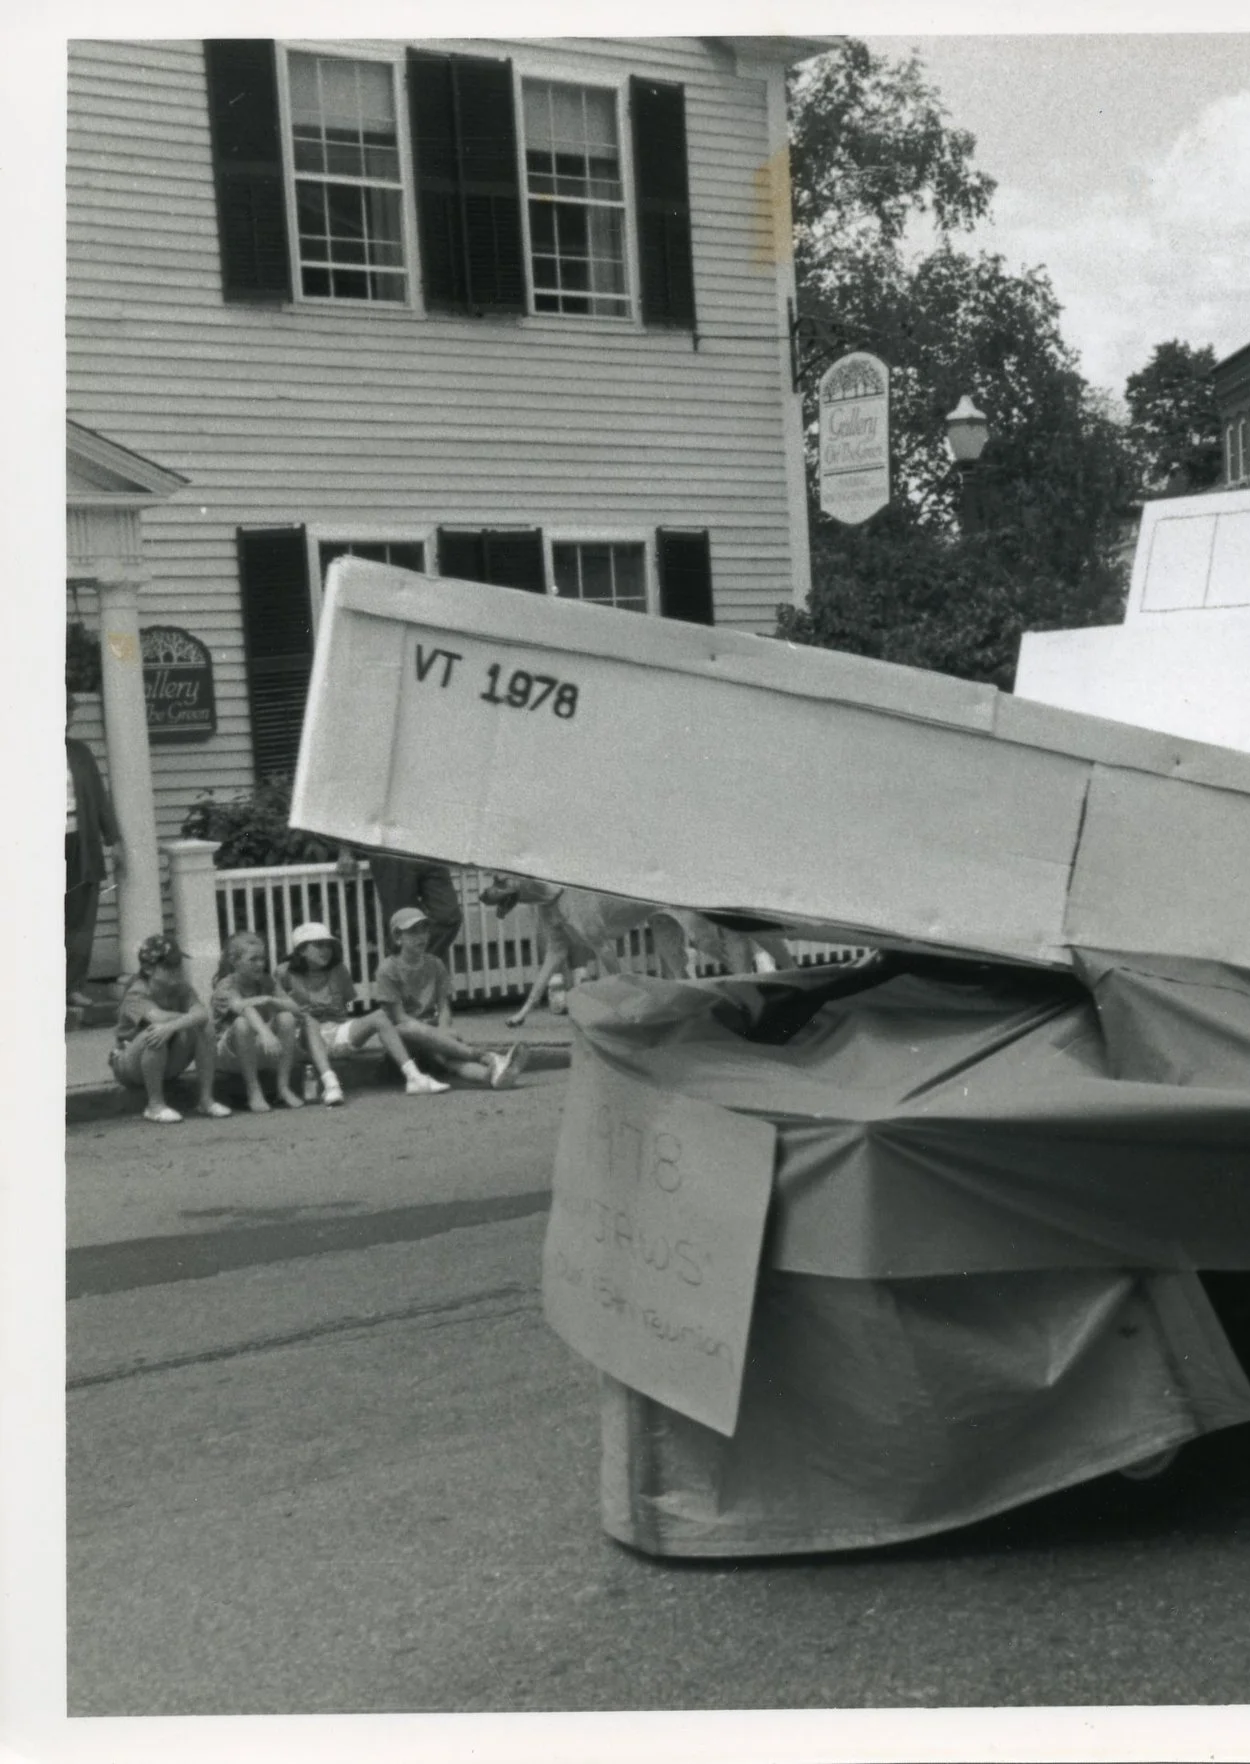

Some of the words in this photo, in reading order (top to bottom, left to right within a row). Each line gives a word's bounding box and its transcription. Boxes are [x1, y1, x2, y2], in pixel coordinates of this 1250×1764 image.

[145, 669, 200, 706] allery
[415, 643, 463, 688] VT
[479, 662, 579, 719] 1978
